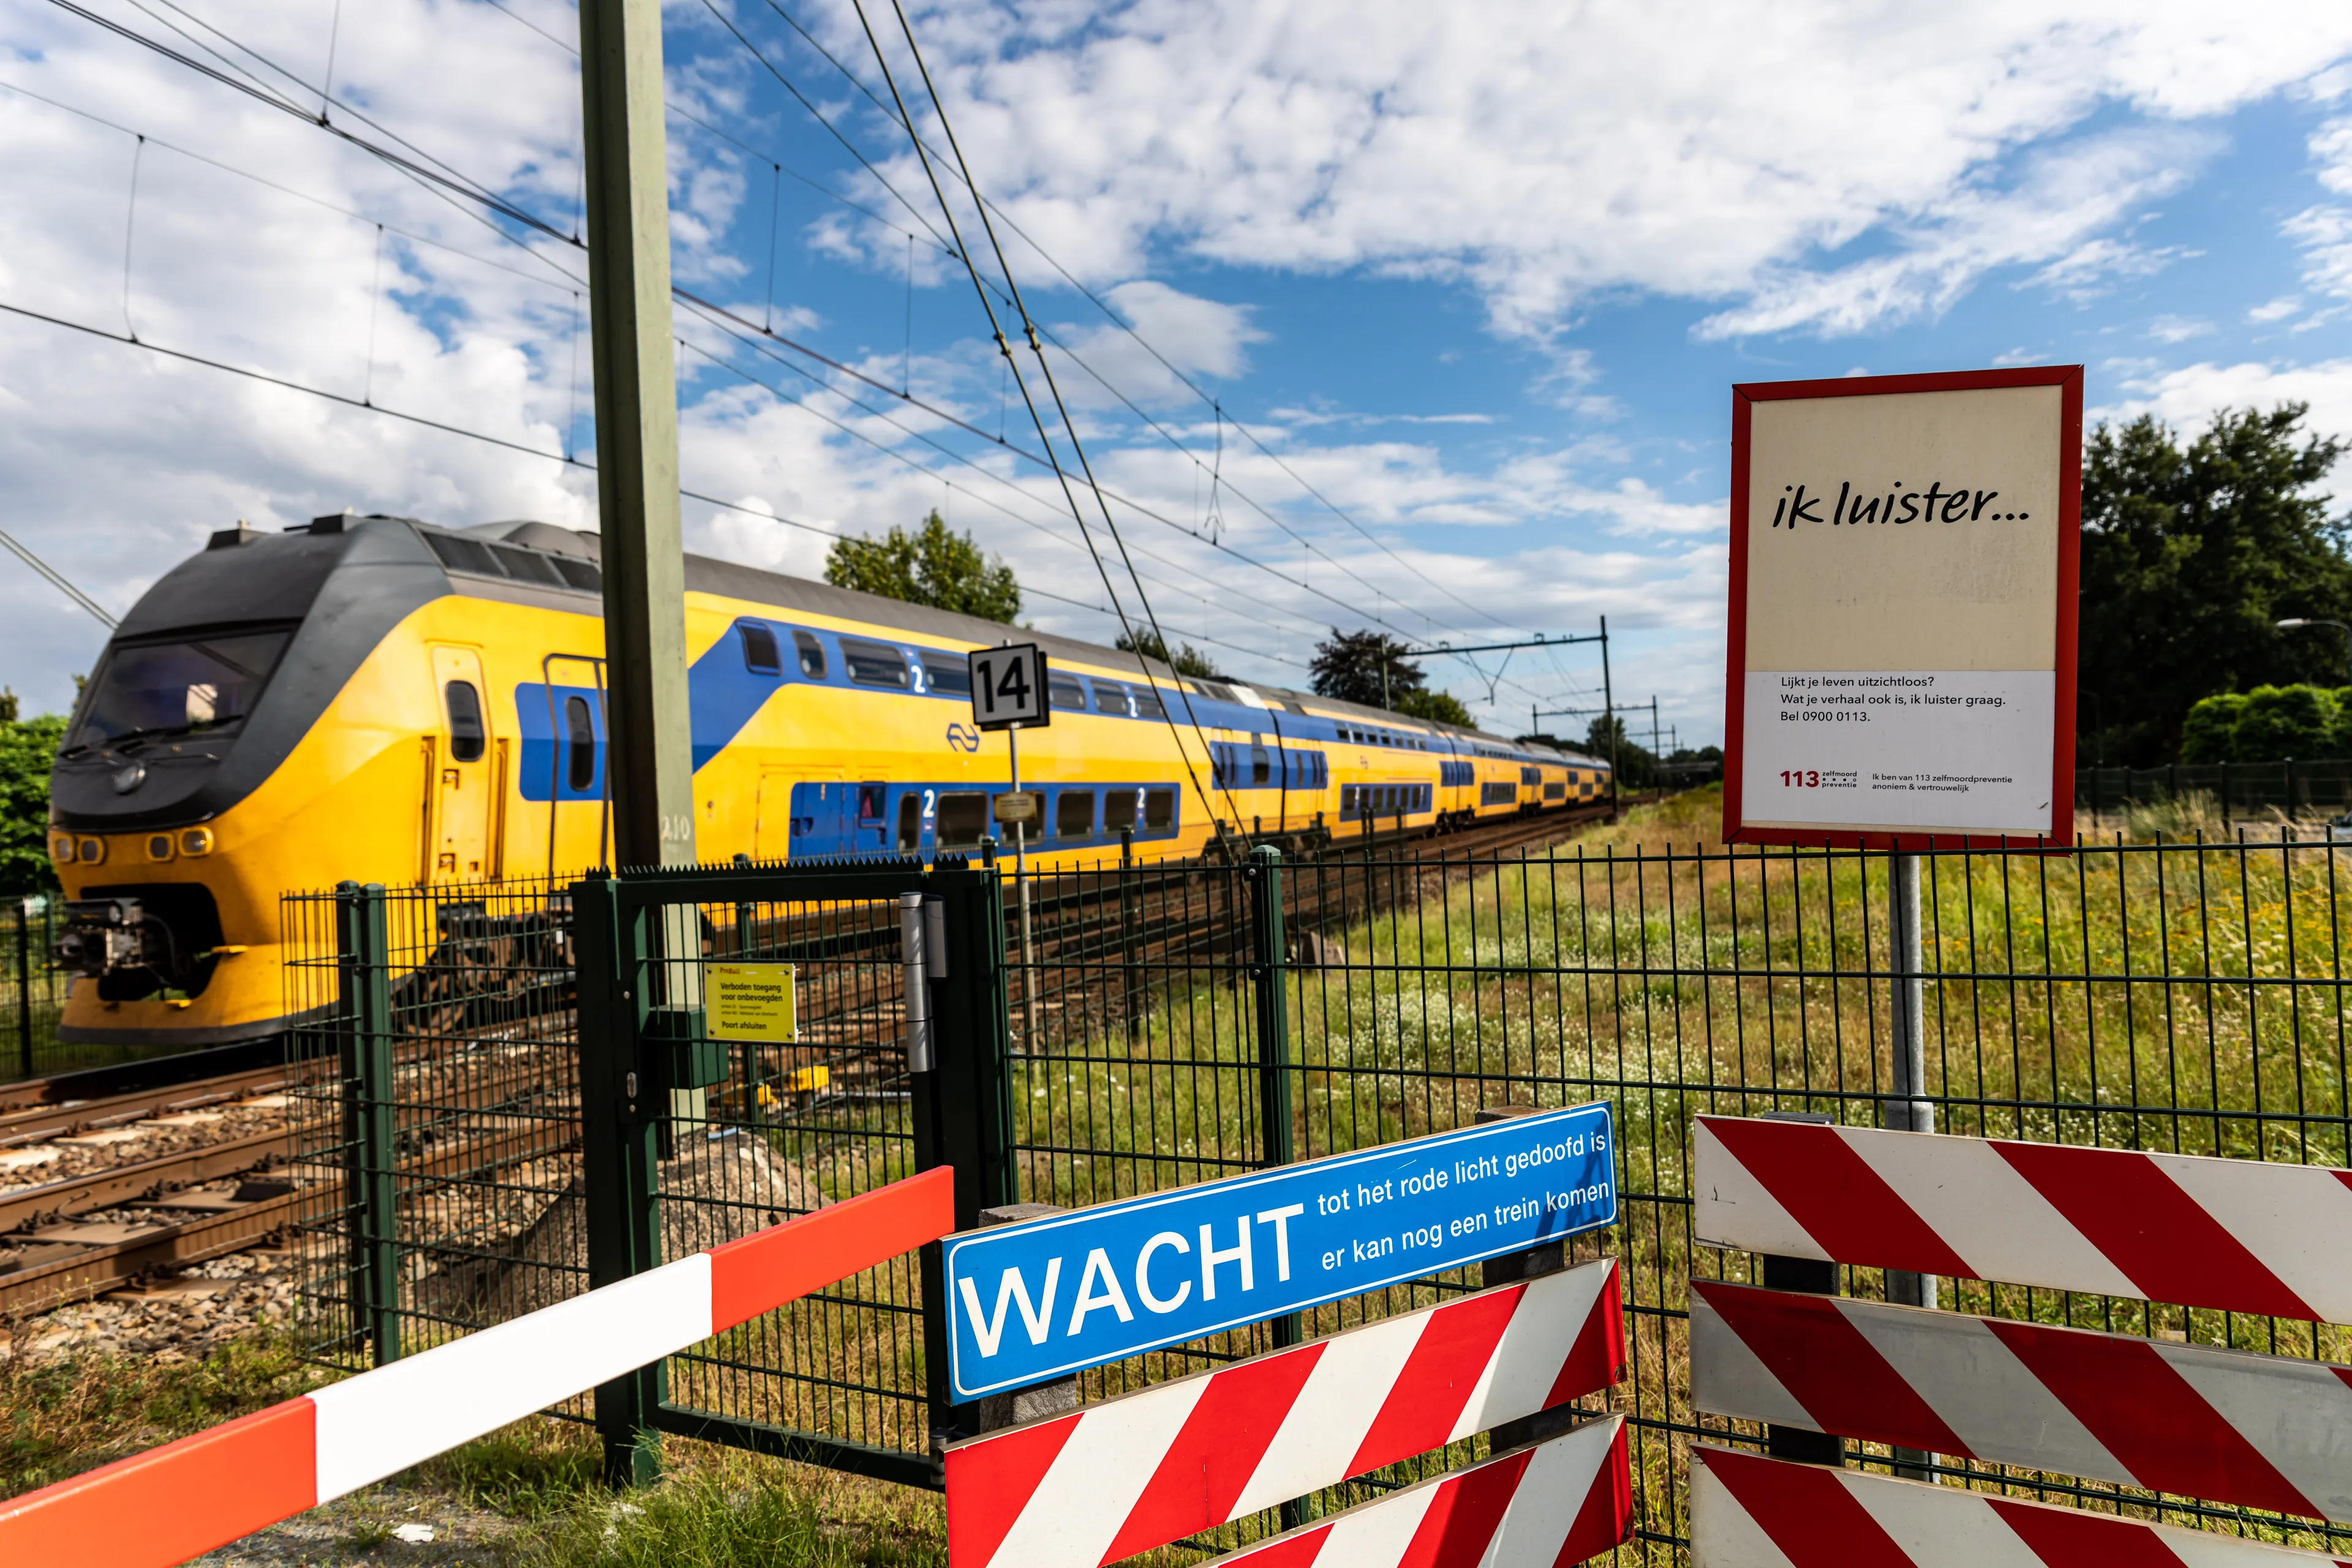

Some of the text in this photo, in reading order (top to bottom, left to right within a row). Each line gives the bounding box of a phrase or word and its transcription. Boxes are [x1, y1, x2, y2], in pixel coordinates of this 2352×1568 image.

[1773, 481, 2029, 529] ik luister...
[910, 665, 925, 693] 2
[977, 656, 1031, 713] 14
[1781, 676, 1934, 689] Lijkt je leven uitzichtloos?
[1781, 694, 2006, 707] Wat je verhaal ook is, ik luister graag.
[1781, 711, 1871, 722] Bel 0900 0113.
[1780, 771, 1819, 787] 113
[1932, 775, 2013, 784] zelfmoordpreventie
[1917, 784, 1969, 793] vertrouwelijk
[923, 789, 935, 818] 2
[720, 982, 782, 993] Verboden toegang
[737, 993, 783, 1003] onbevoegden
[1317, 1131, 1606, 1216] tot het rode licht gedoofd is
[1322, 1182, 1609, 1271] er kan nog een trein komen
[957, 1203, 1305, 1359] WACHT
